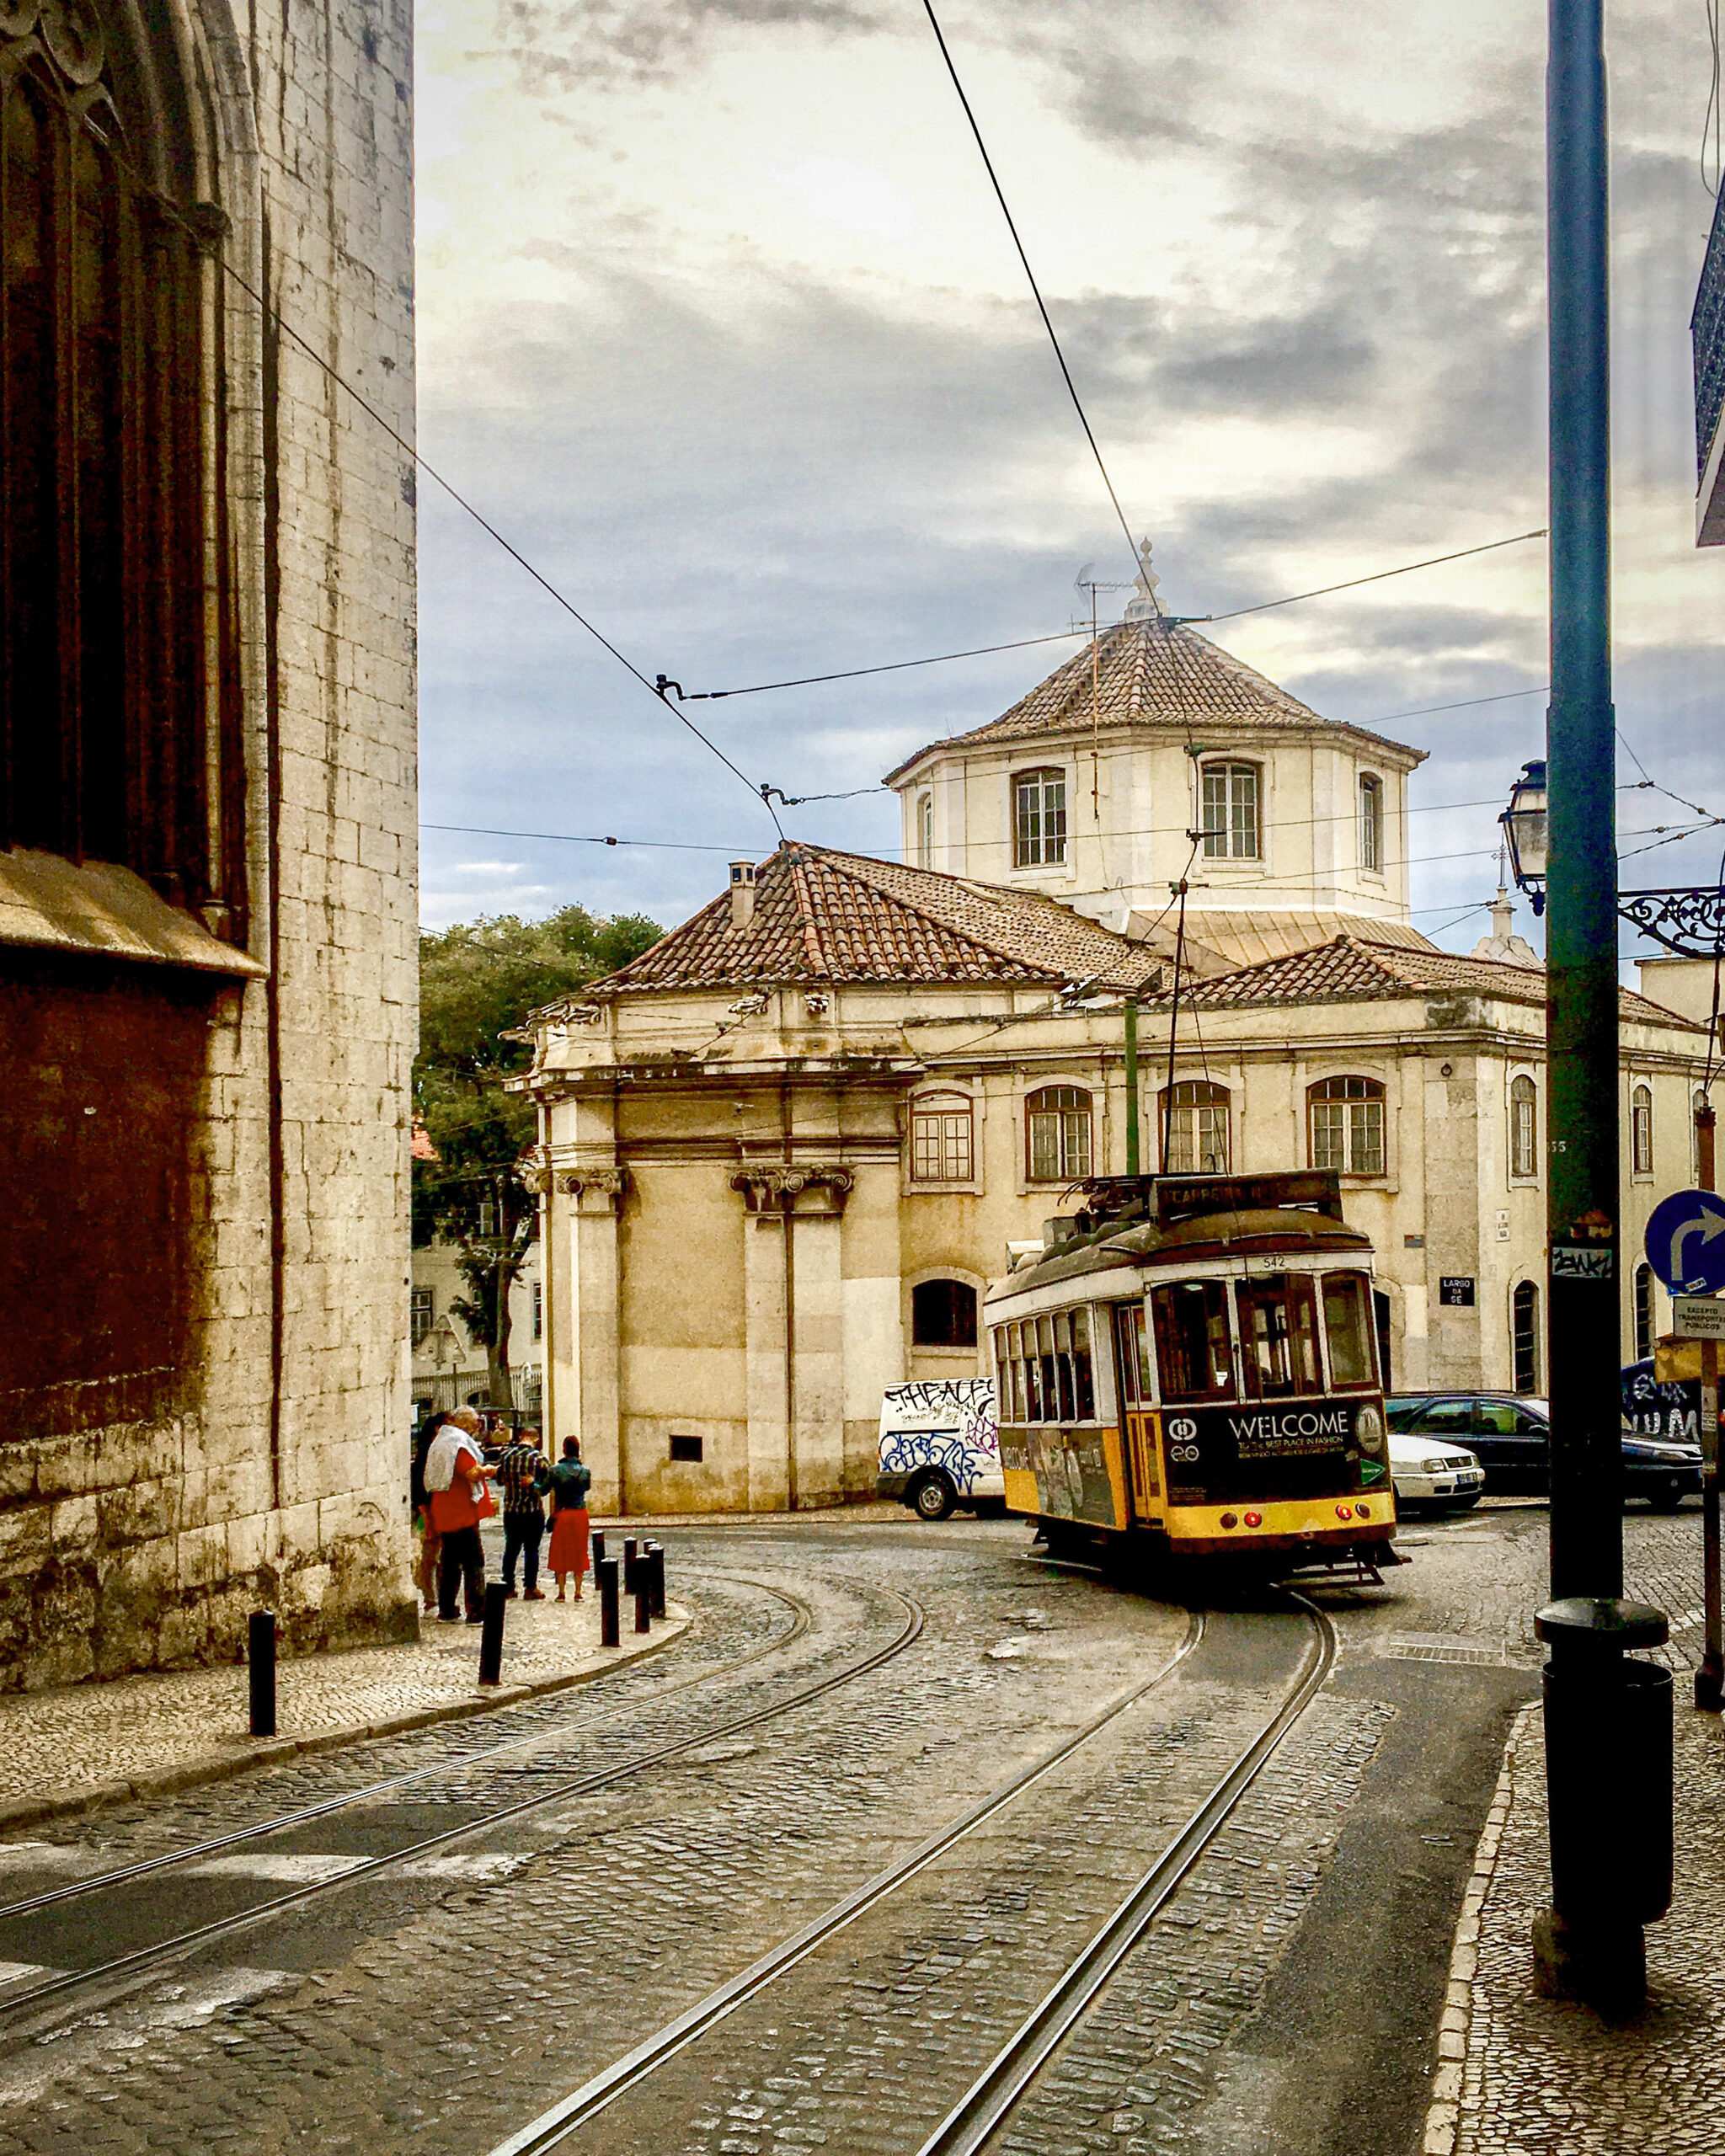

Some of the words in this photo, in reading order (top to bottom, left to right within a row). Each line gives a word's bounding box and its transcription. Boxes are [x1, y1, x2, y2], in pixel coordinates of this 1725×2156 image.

[1263, 1256, 1285, 1268] 542
[1443, 1279, 1471, 1288] LARGO
[1228, 1411, 1348, 1439] WELCOME
[1266, 1439, 1282, 1448] BEST
[1284, 1438, 1304, 1447] PLACE
[1315, 1435, 1343, 1444] FASHION
